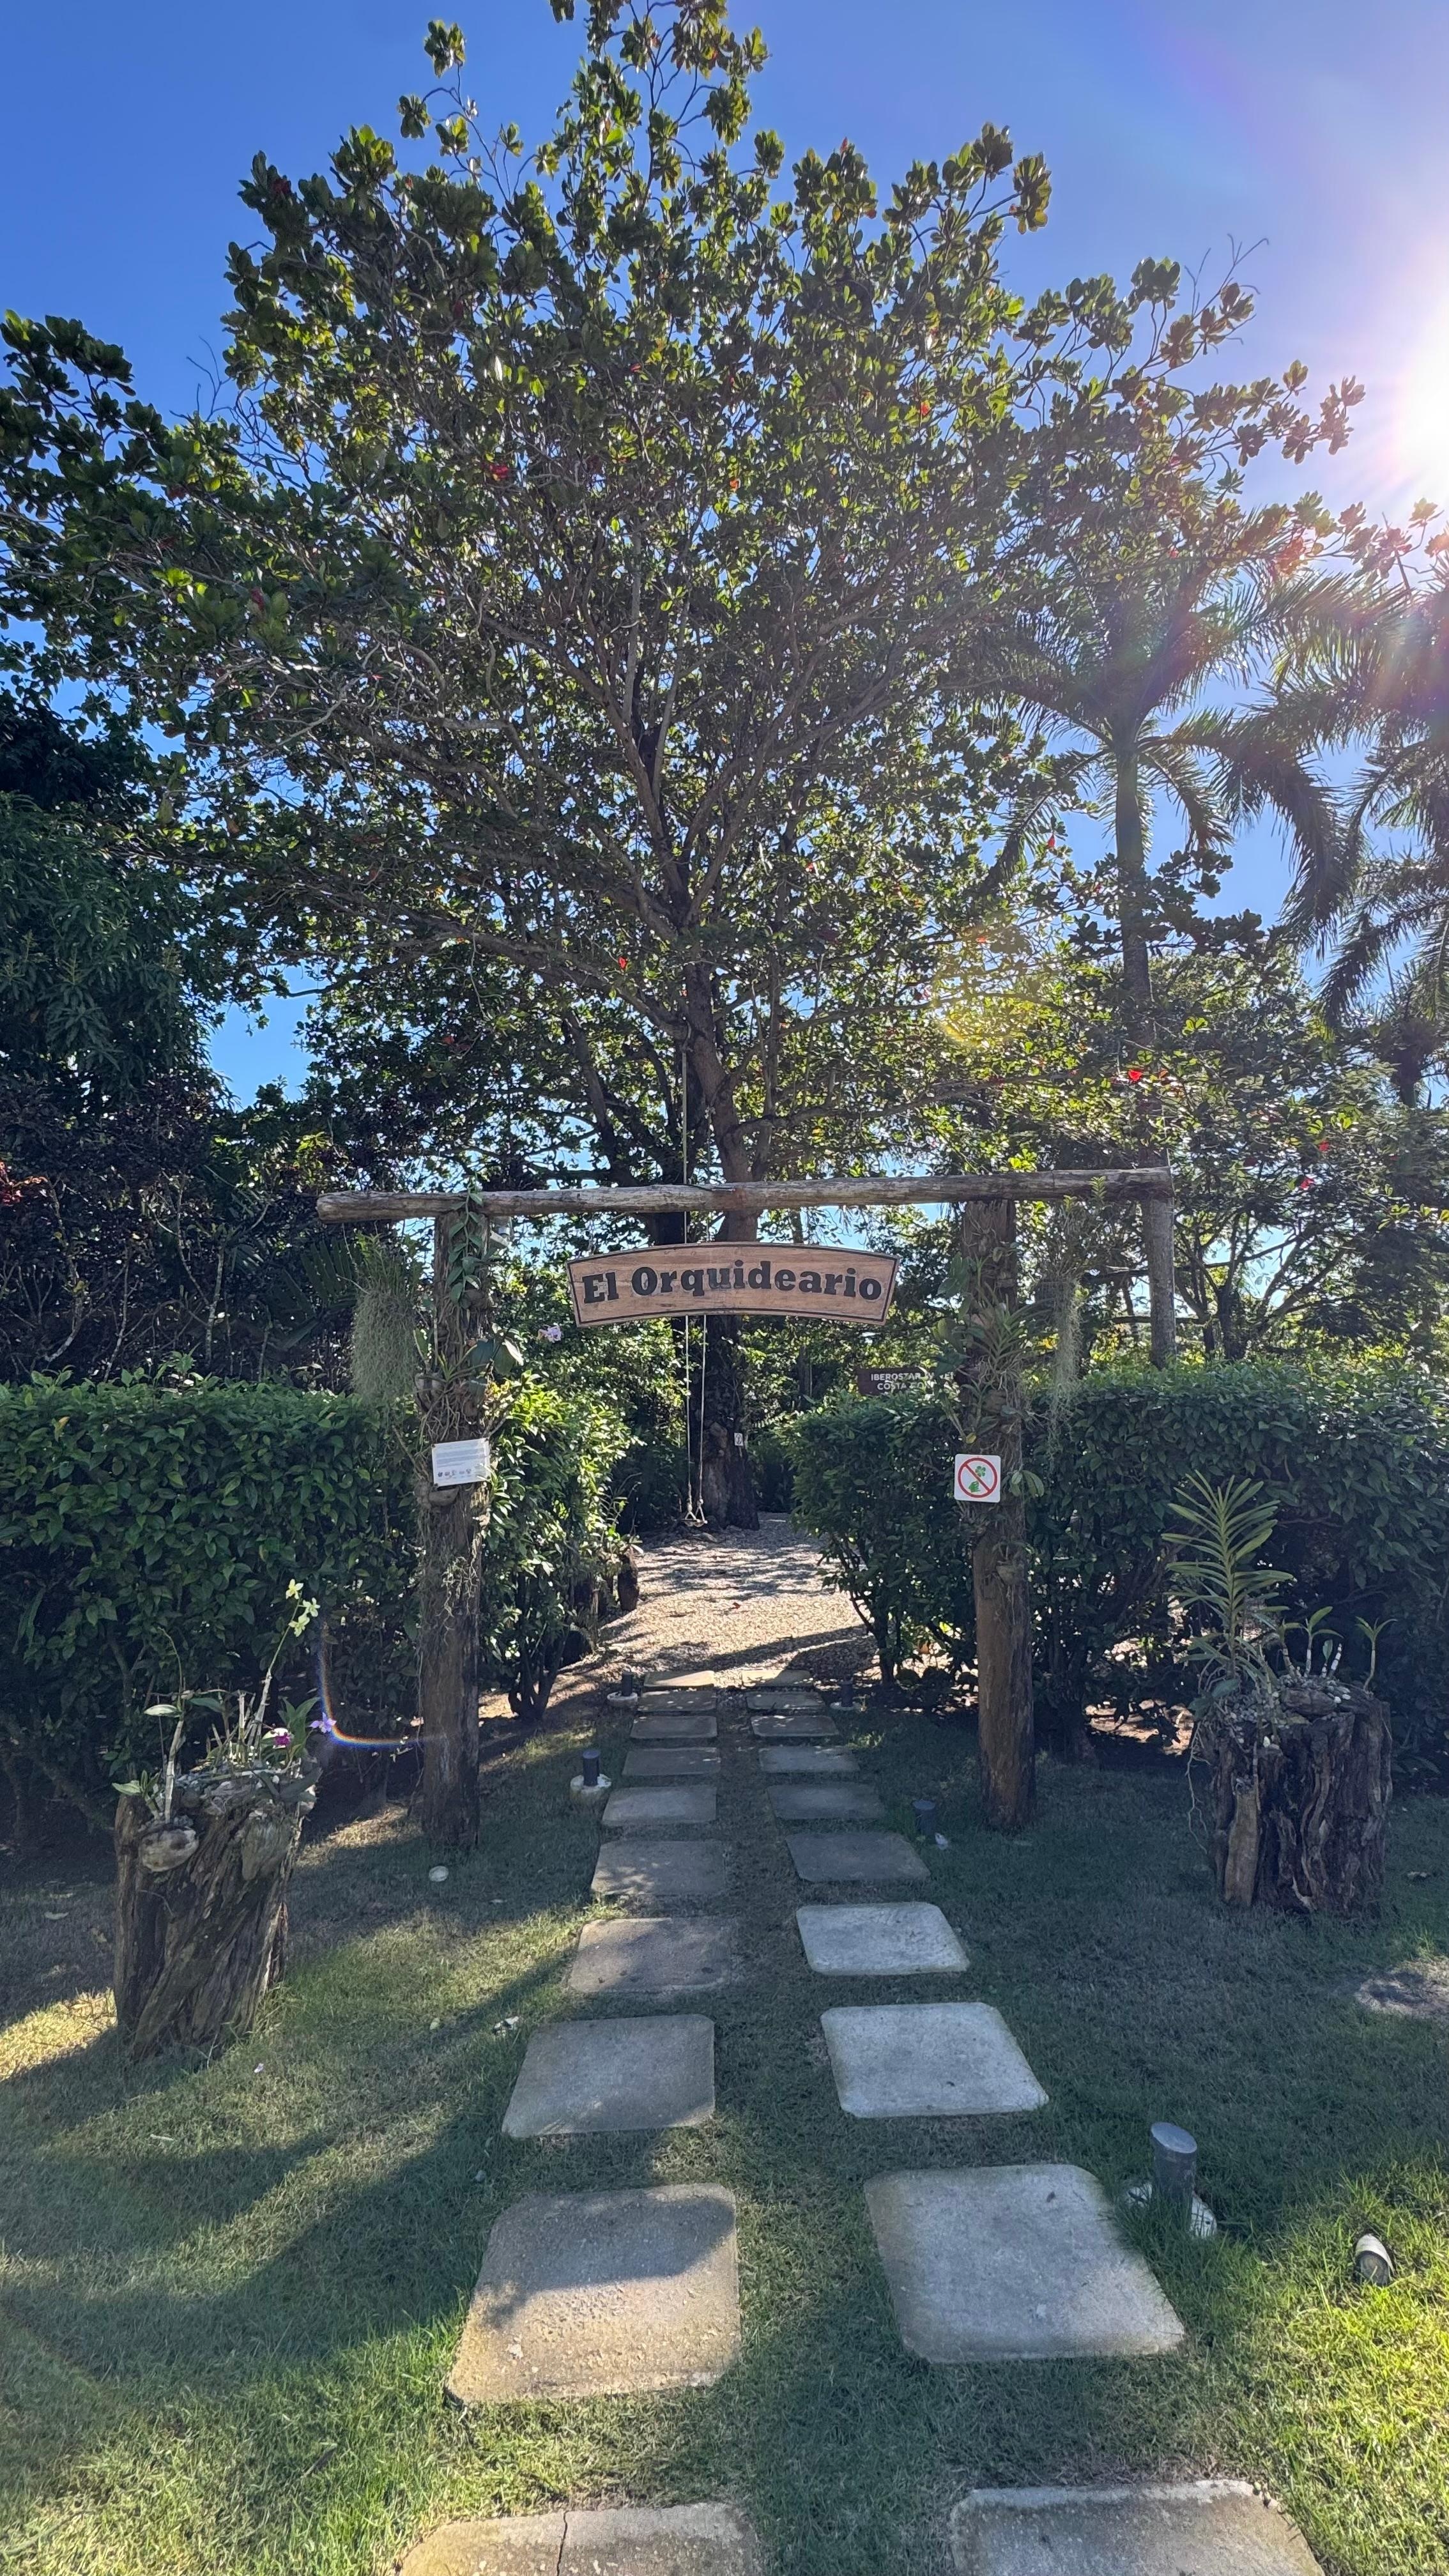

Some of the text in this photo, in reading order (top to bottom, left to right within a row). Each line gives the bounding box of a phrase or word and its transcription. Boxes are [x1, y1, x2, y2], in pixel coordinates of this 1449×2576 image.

[581, 1259, 882, 1303] El Orquideario
[871, 1372, 921, 1381] IBEROSTAR
